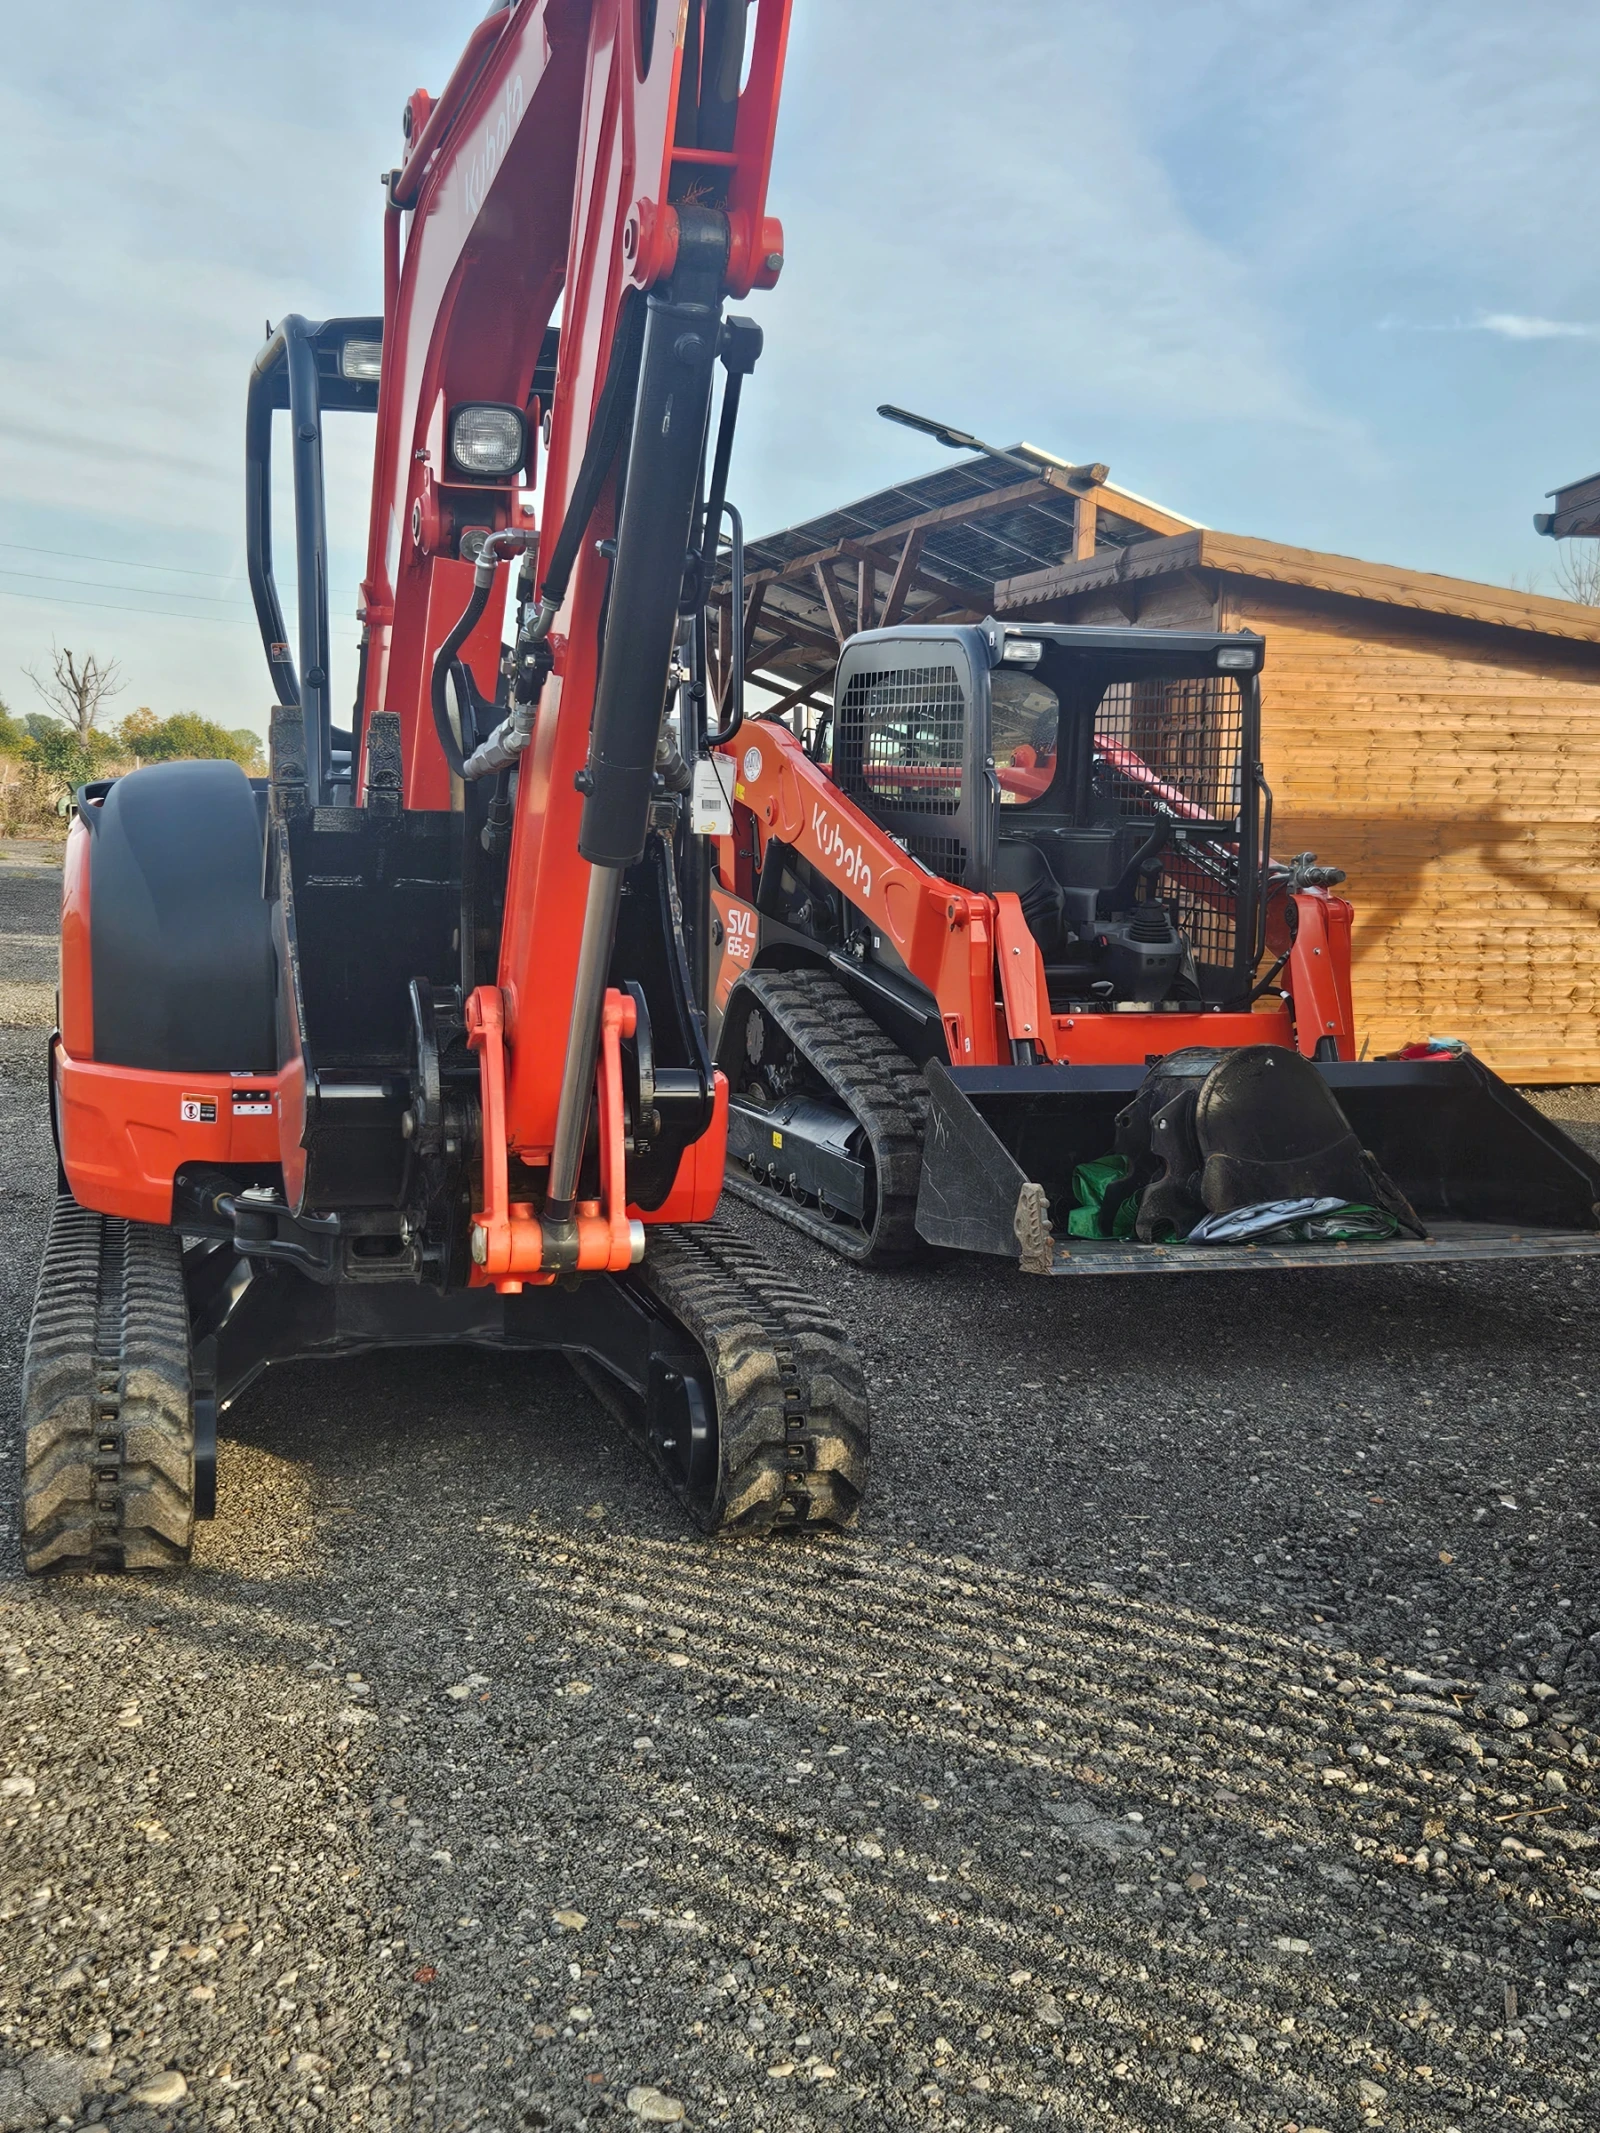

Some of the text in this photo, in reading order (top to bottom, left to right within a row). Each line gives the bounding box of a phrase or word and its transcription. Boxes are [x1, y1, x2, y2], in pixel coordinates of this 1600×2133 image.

[465, 75, 523, 215] Kubota
[812, 803, 871, 897] Kubota
[727, 909, 755, 938] SVL
[728, 937, 749, 958] 65-2
